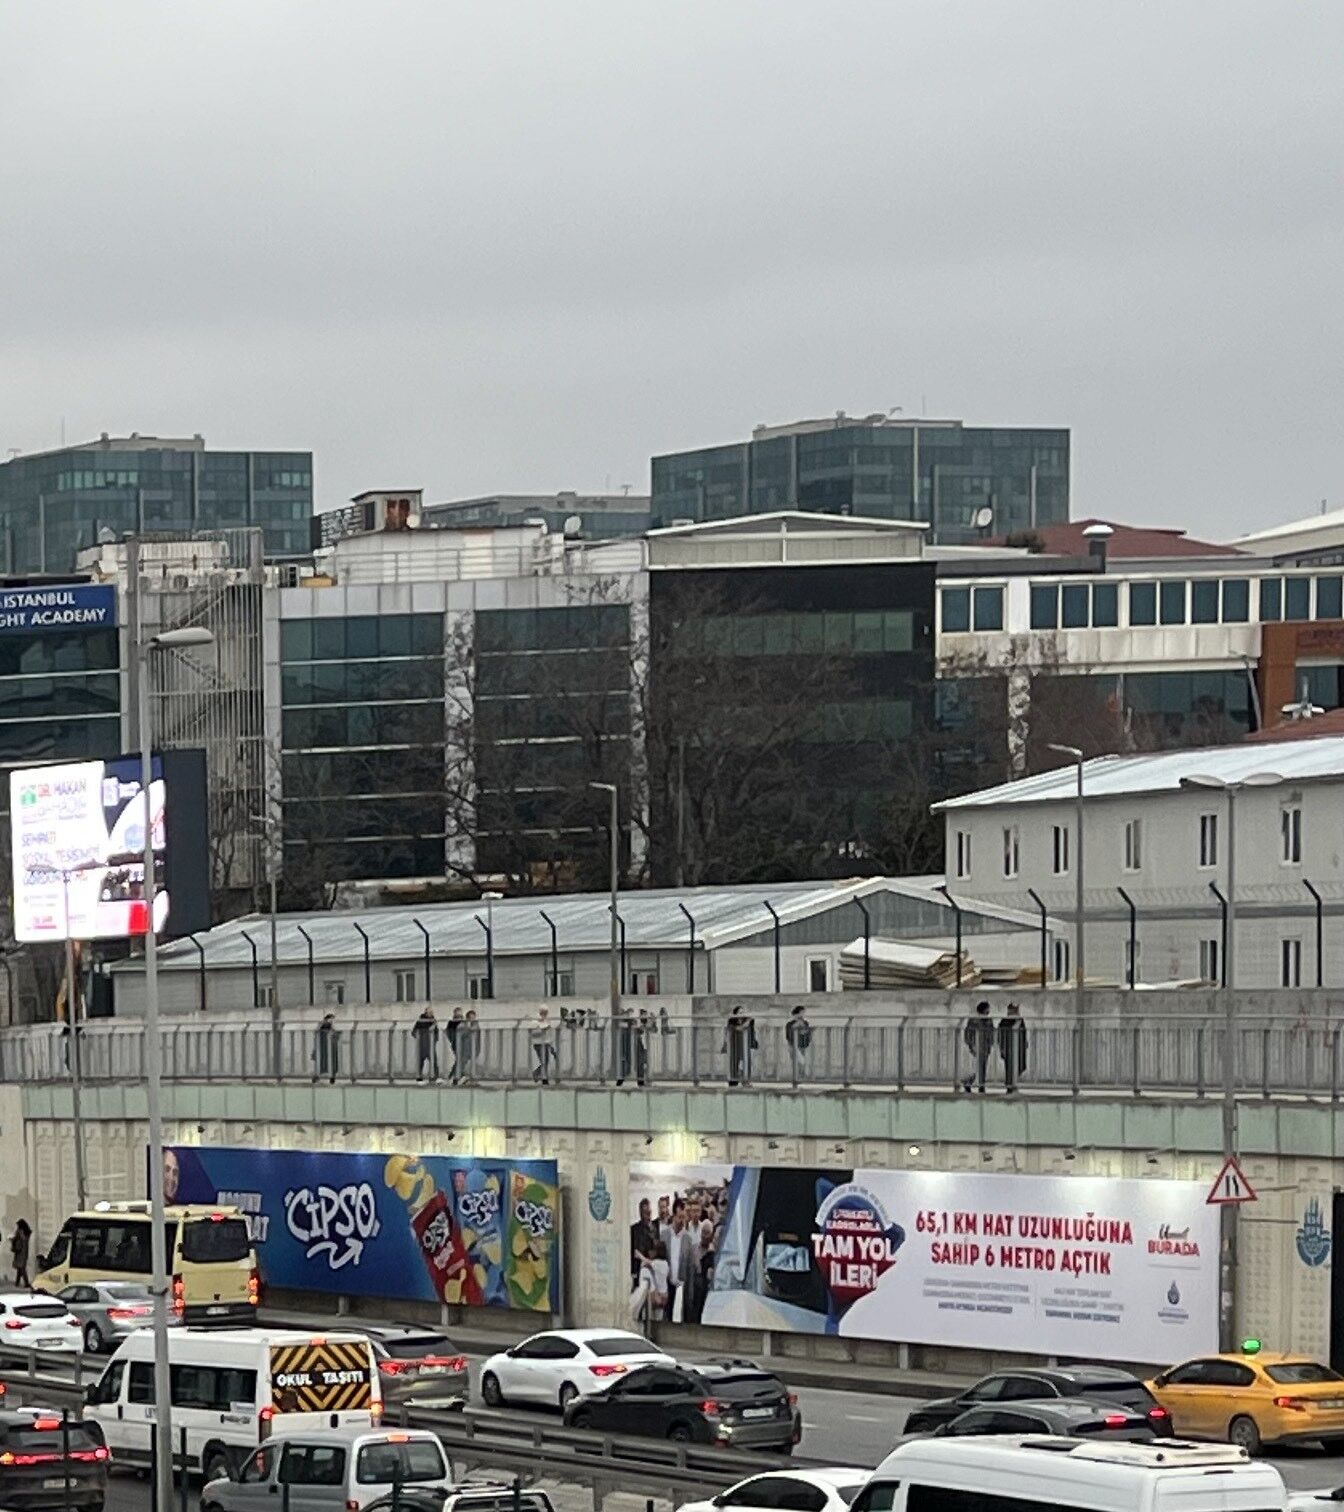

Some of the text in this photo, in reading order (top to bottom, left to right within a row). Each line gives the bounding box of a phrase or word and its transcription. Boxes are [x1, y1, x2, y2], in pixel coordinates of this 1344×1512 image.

[31, 608, 107, 626] ACADEMY
[915, 1210, 1133, 1245] 65,1 KM HAT UZUNLUĞUNA
[810, 1233, 896, 1262] TAM YOL
[930, 1237, 1111, 1278] SAHİP 6 METRO AÇTIK
[1147, 1240, 1201, 1257] BURADA
[830, 1259, 878, 1289] İLERİ
[276, 1370, 364, 1387] OKUL TAŞITI
